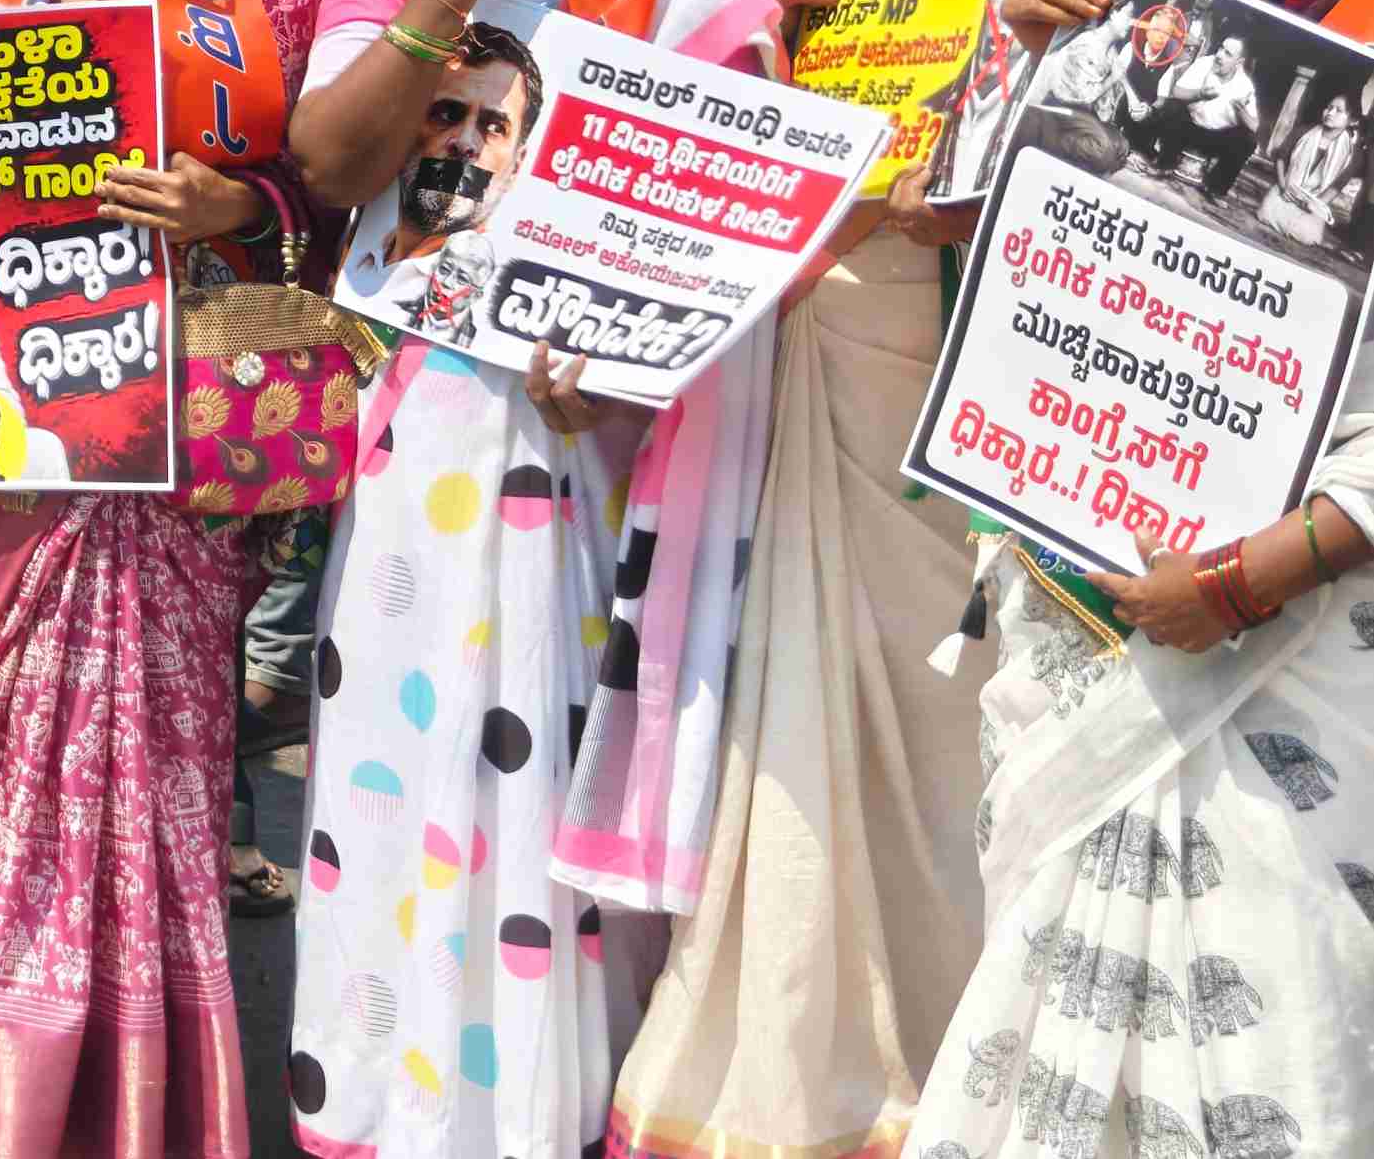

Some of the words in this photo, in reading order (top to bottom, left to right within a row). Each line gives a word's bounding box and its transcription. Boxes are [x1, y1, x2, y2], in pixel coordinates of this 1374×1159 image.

[578, 55, 696, 112] ರಾಹುಲ್
[697, 93, 784, 148] ಗಾಂಧಿ
[784, 122, 853, 162] ಅವರೇ
[581, 113, 605, 141] 11
[685, 240, 714, 261] MP
[1002, 228, 1096, 298] ಲೈಂಗಿಕ
[1044, 185, 1148, 261] ಸ್ವಪಕ್ಷದ
[1152, 234, 1293, 318] ಸಂಸದನ
[18, 300, 158, 400] ಧಿಕ್ಕಾರ!
